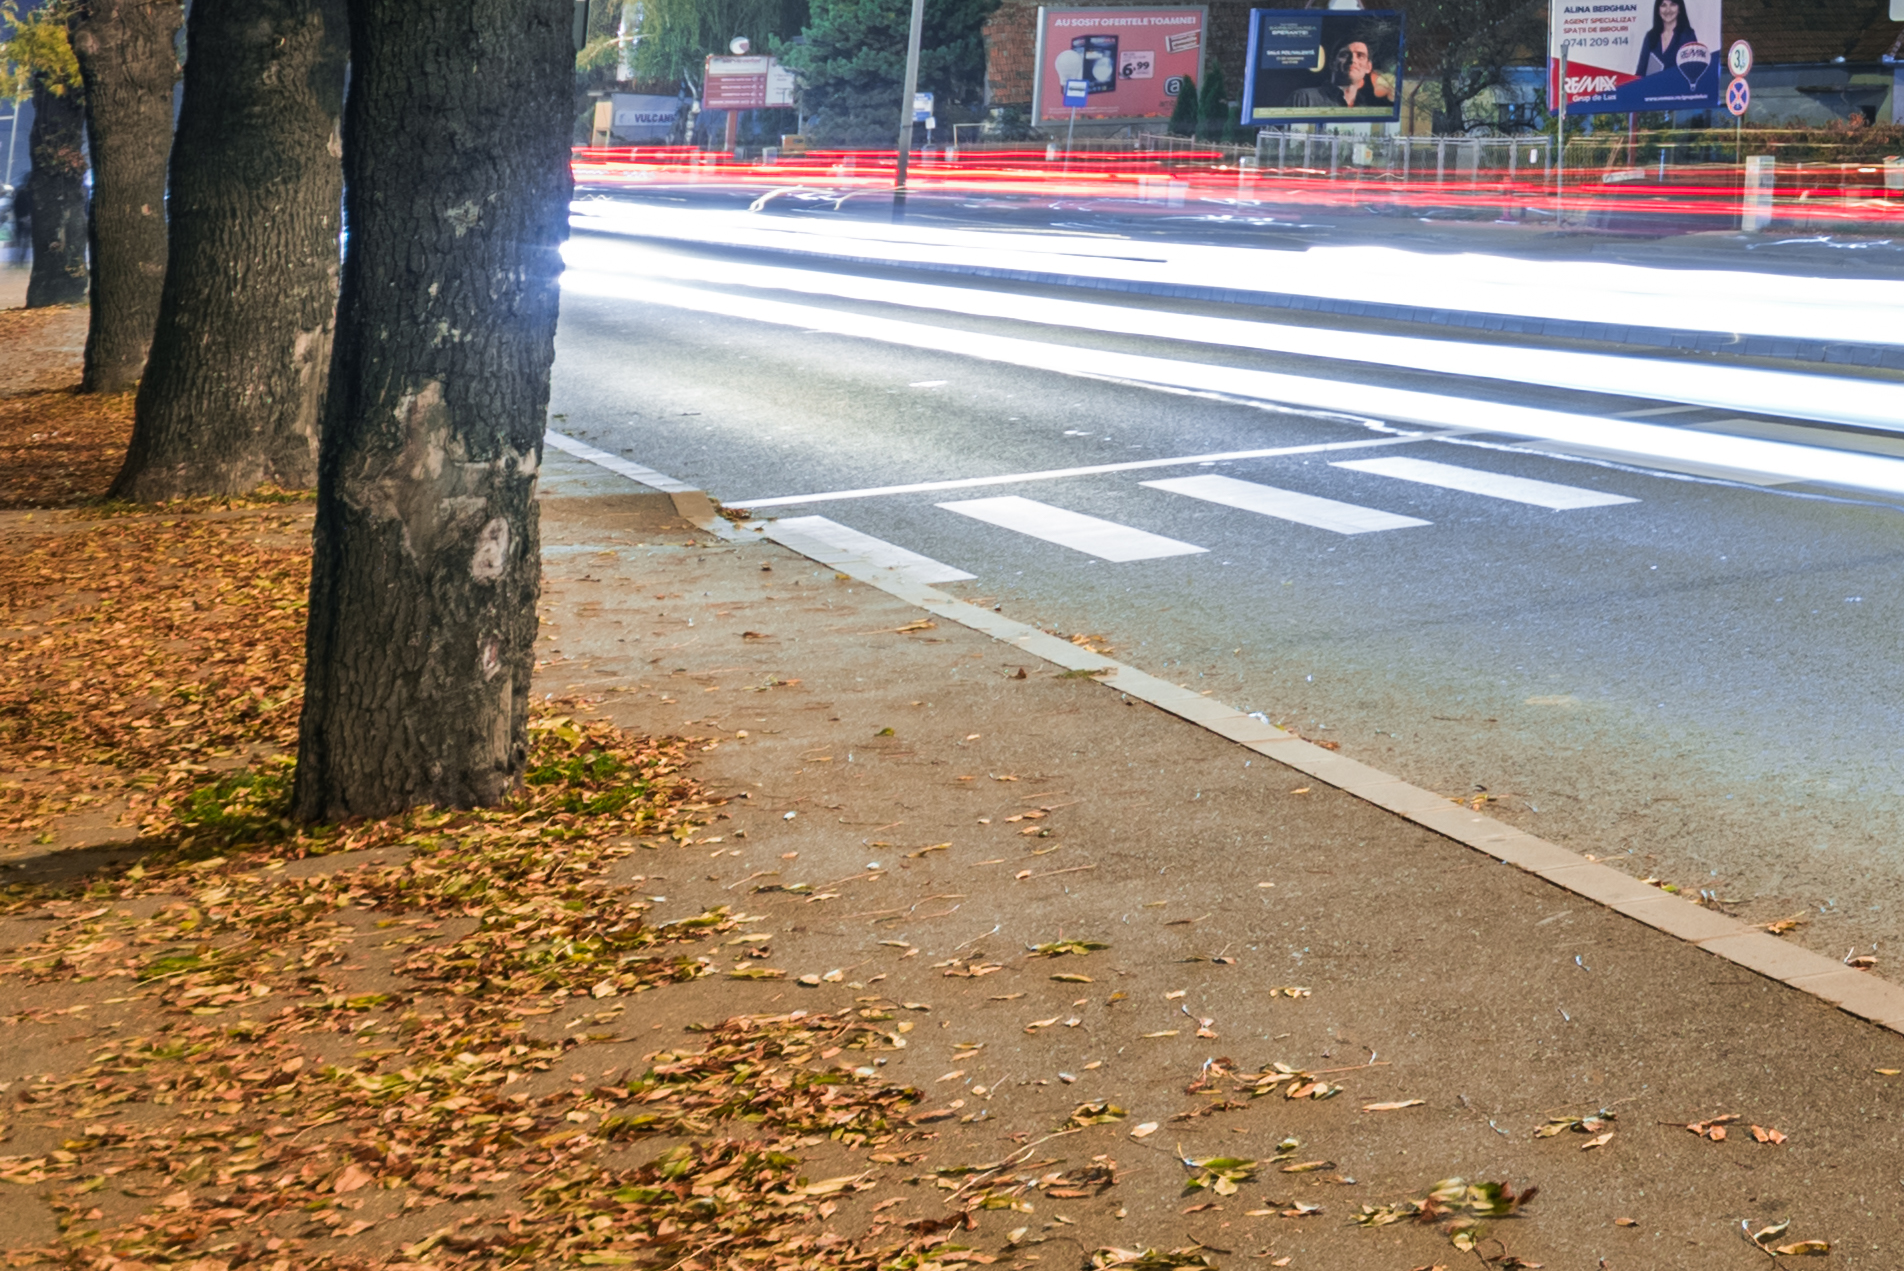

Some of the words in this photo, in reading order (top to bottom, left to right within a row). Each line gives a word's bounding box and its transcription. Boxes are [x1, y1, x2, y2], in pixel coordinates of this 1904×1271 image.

[1564, 5, 1591, 14] ALINA
[1592, 4, 1637, 13] BERGHIAN
[1054, 18, 1071, 27] AU
[1071, 17, 1101, 27] SOSIT
[1100, 17, 1149, 27] OFERTELE
[1563, 18, 1590, 26] AGENT
[1590, 16, 1637, 25] SPECIALIZAT
[1599, 25, 1629, 33] BIROURI
[1562, 38, 1587, 47] 0741
[1589, 37, 1610, 46] 209
[1611, 36, 1629, 46] 414
[1564, 75, 1618, 93] RE/MAX
[1571, 94, 1591, 103] Grup
[1591, 94, 1602, 102] de
